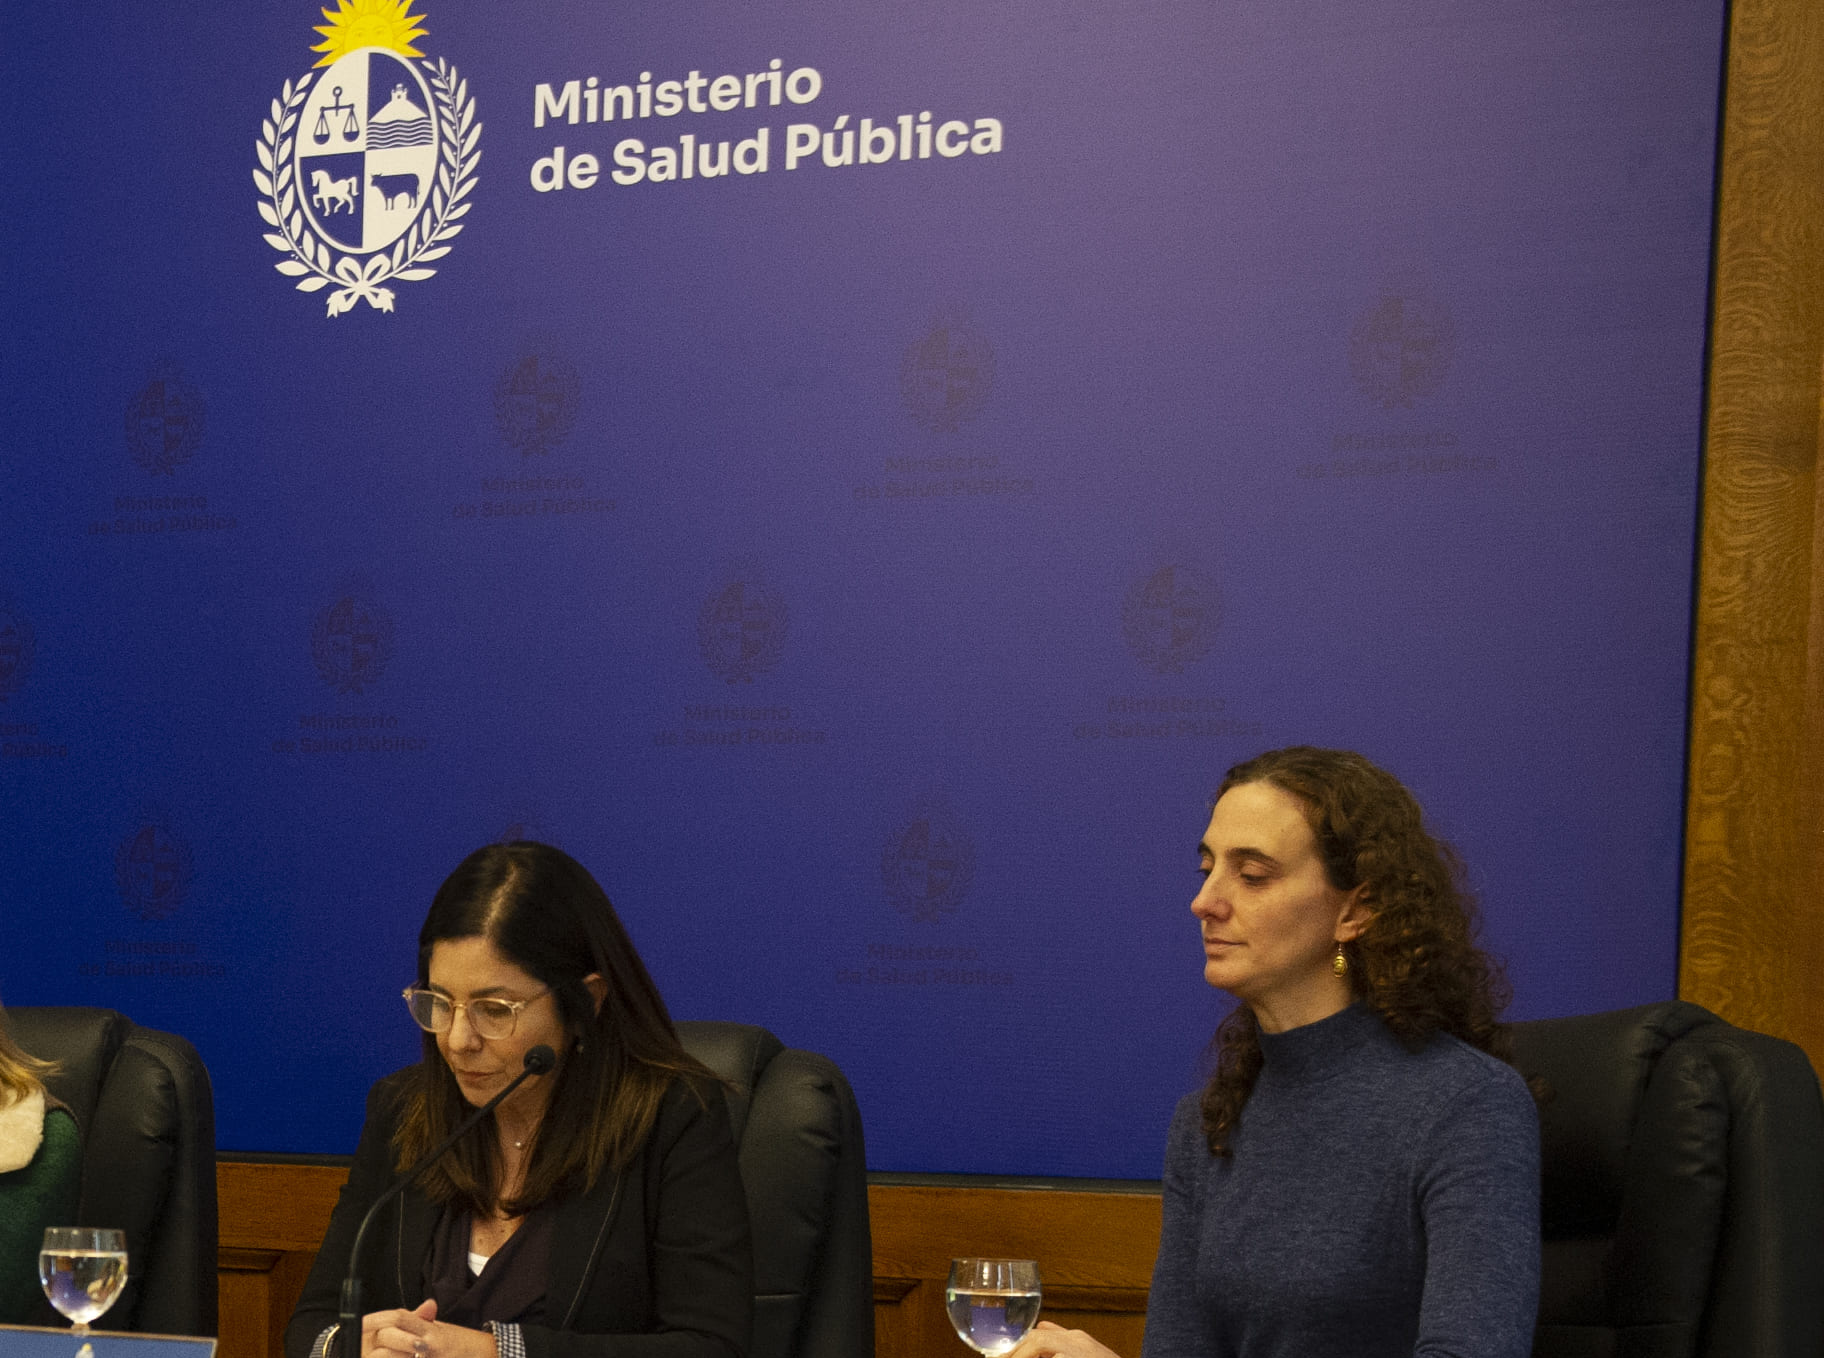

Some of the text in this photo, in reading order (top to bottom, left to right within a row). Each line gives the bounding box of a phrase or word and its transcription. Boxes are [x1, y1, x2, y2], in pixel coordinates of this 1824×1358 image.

[534, 59, 822, 128] Ministerio
[530, 111, 1003, 192] de Salud Pública
